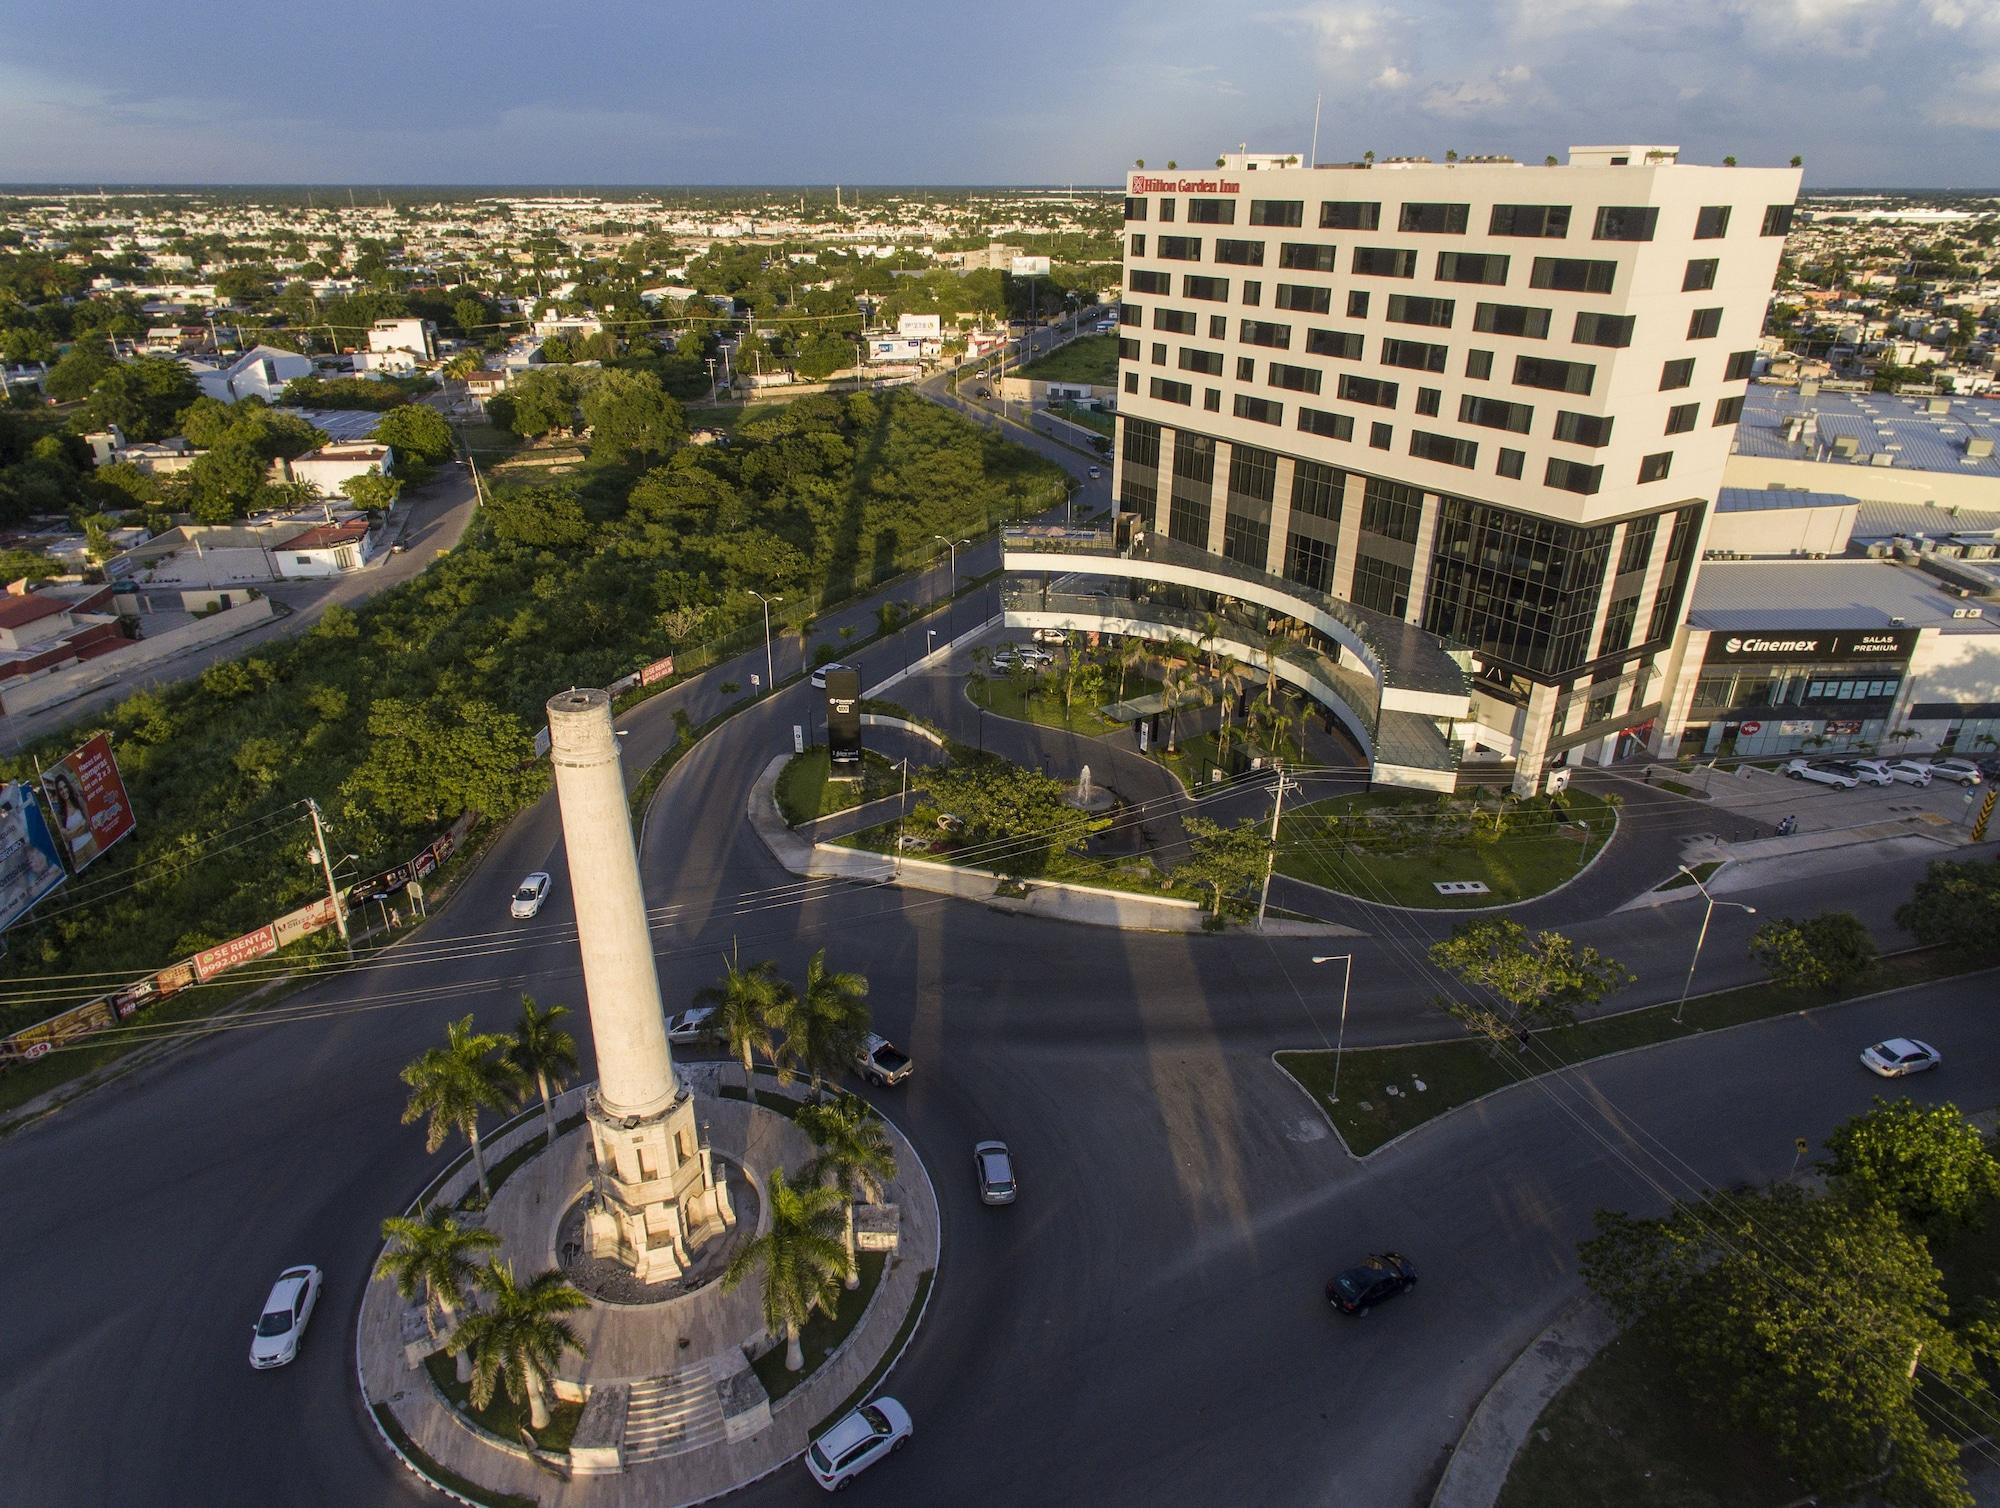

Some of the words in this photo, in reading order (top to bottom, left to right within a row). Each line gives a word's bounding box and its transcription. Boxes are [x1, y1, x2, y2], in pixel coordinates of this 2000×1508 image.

[1144, 178, 1177, 192] Hilton
[1178, 178, 1217, 193] Garden
[1219, 179, 1240, 193] Inn
[1742, 638, 1819, 652] Cinemex
[1862, 636, 1894, 644] SALAS
[1852, 644, 1898, 652] PREMIUM
[213, 948, 229, 960] SE
[230, 931, 268, 952] RENTA
